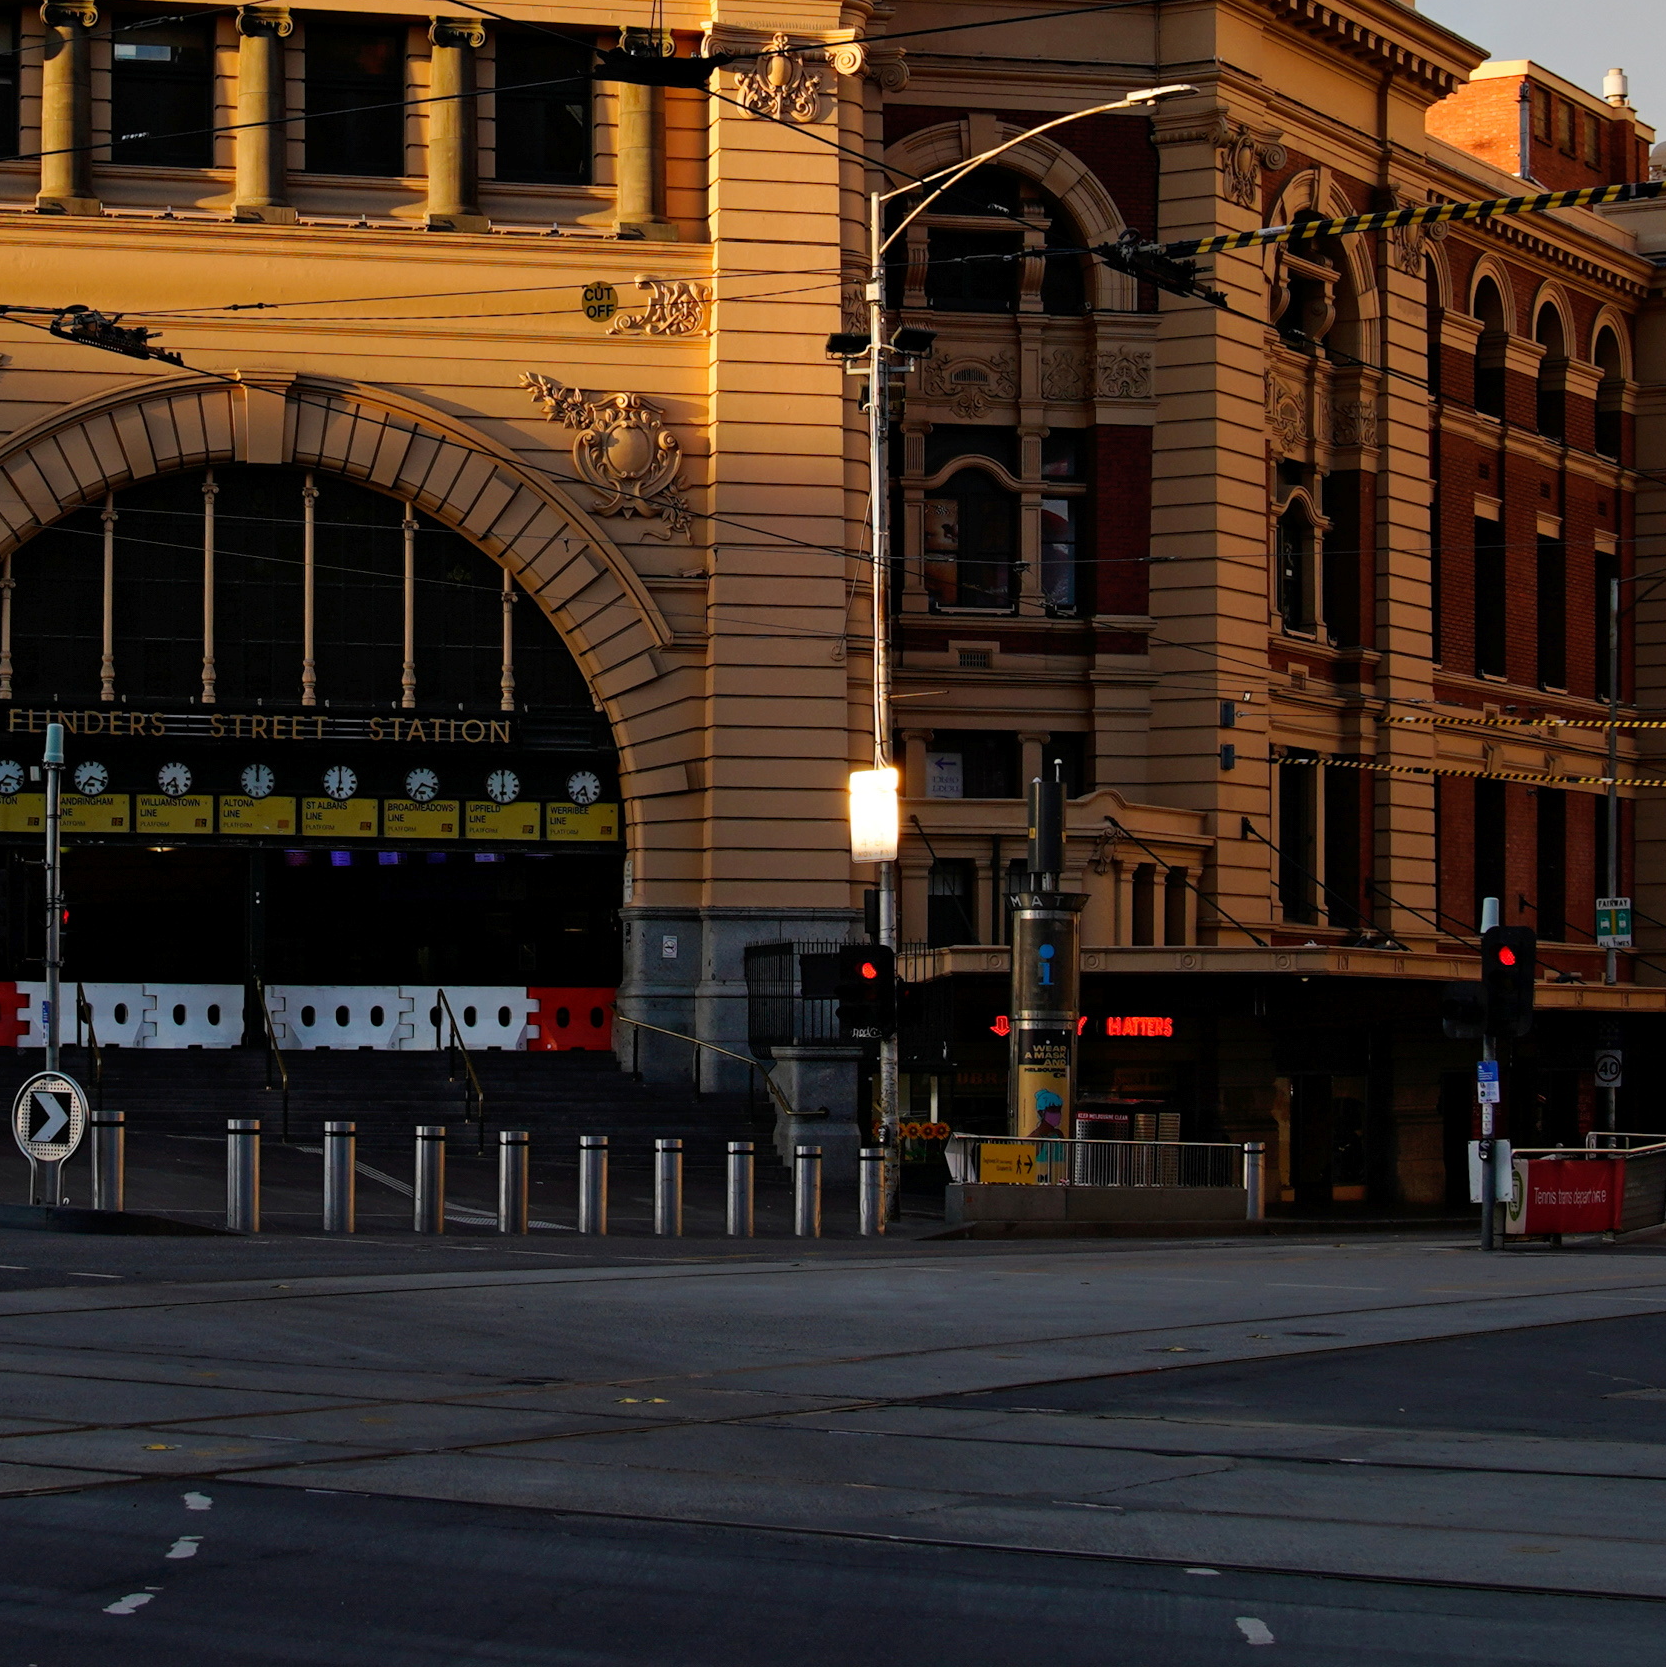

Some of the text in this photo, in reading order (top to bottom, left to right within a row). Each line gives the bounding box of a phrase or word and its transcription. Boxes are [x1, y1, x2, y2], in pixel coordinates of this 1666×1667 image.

[584, 287, 614, 301] CUT
[586, 304, 615, 318] OFF
[8, 709, 511, 744] FLINDERS STREET STATION
[60, 797, 113, 806] ANDRINGHAM
[140, 798, 200, 806] WILLIAMSTOWN
[223, 799, 254, 807] ALTONA
[306, 801, 348, 810] ST ALBANS
[387, 803, 454, 811] BROADMEADOWS
[60, 808, 73, 816] INE
[140, 809, 157, 817] LINE
[223, 810, 241, 818] LINE
[306, 812, 323, 820] LINE
[388, 814, 404, 822] LINE
[469, 815, 486, 823] LINE
[550, 817, 567, 825] LINE
[1598, 900, 1628, 908] FAIRWAY
[1612, 938, 1630, 947] TIMES
[1107, 1016, 1174, 1037] HATTERS
[1599, 1061, 1619, 1075] 40
[1534, 1187, 1556, 1205] Tennis
